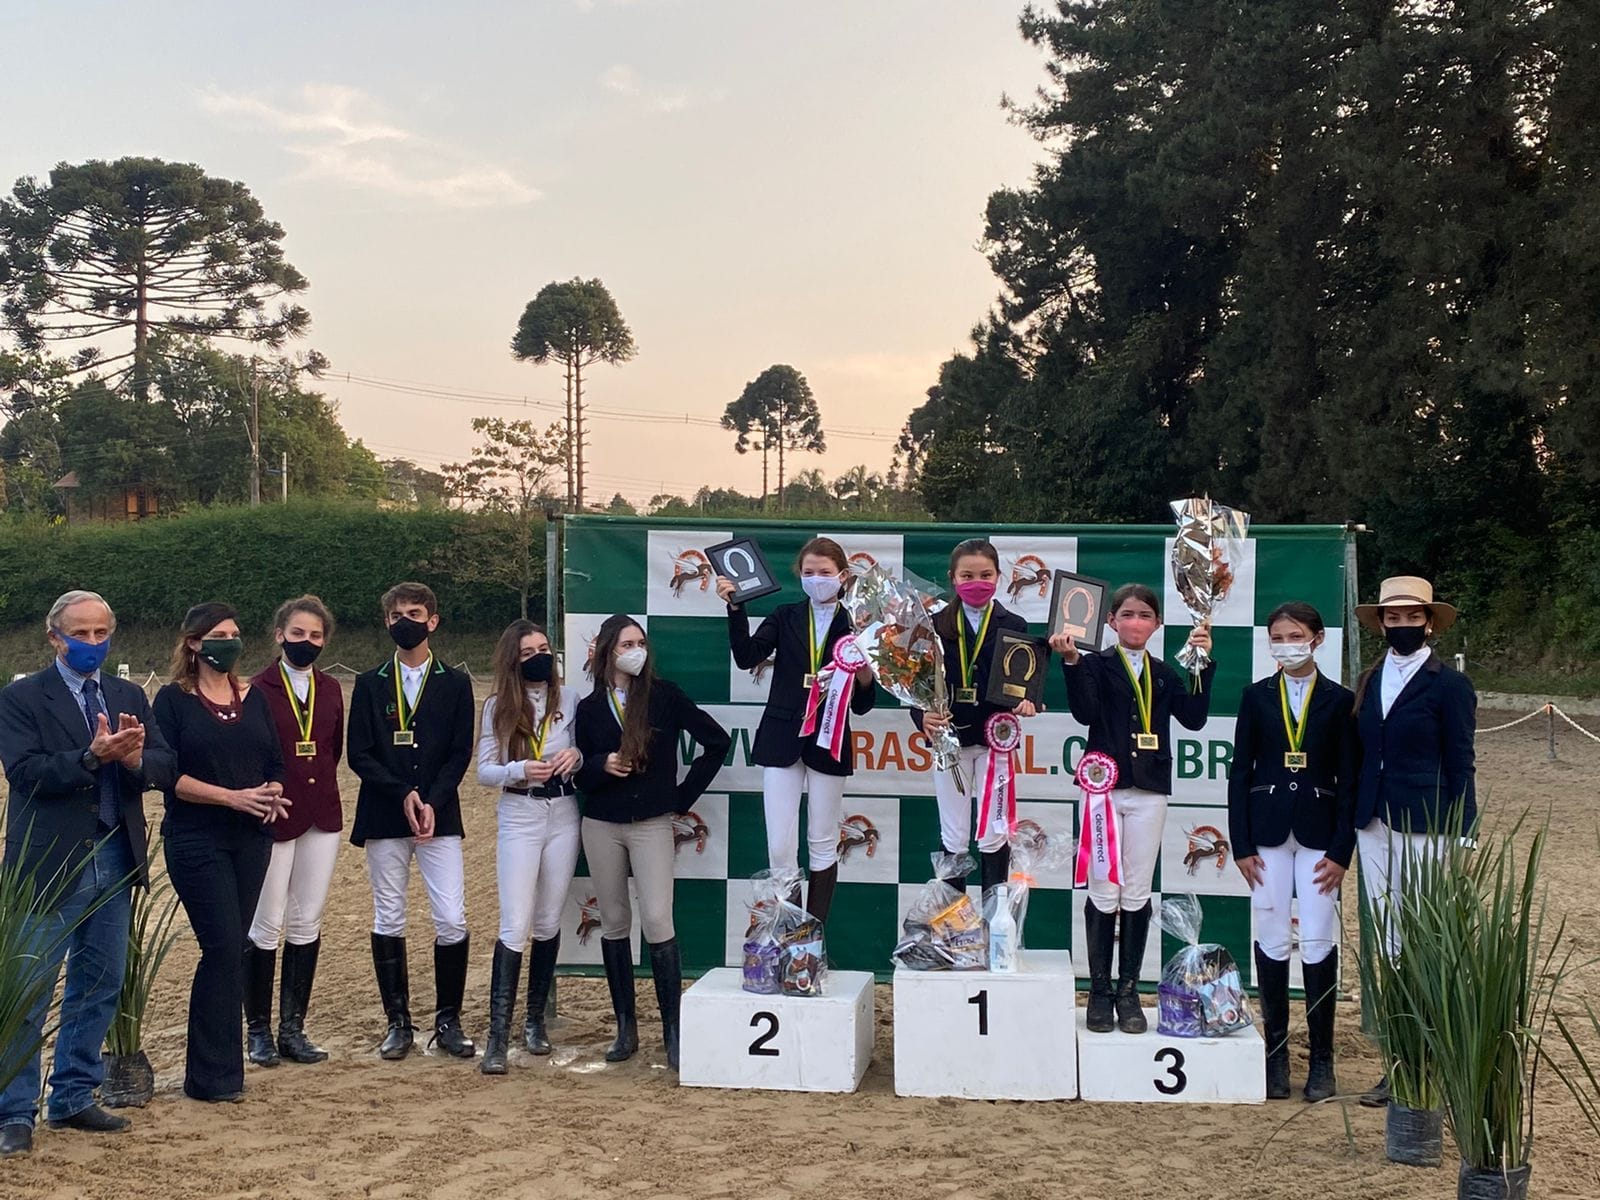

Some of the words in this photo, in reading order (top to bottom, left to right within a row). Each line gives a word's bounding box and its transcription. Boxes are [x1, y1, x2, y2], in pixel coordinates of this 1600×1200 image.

[1095, 813, 1105, 863] clearcorrect
[748, 1011, 780, 1056] 2
[968, 990, 988, 1035] 1
[1153, 1047, 1187, 1095] 3
